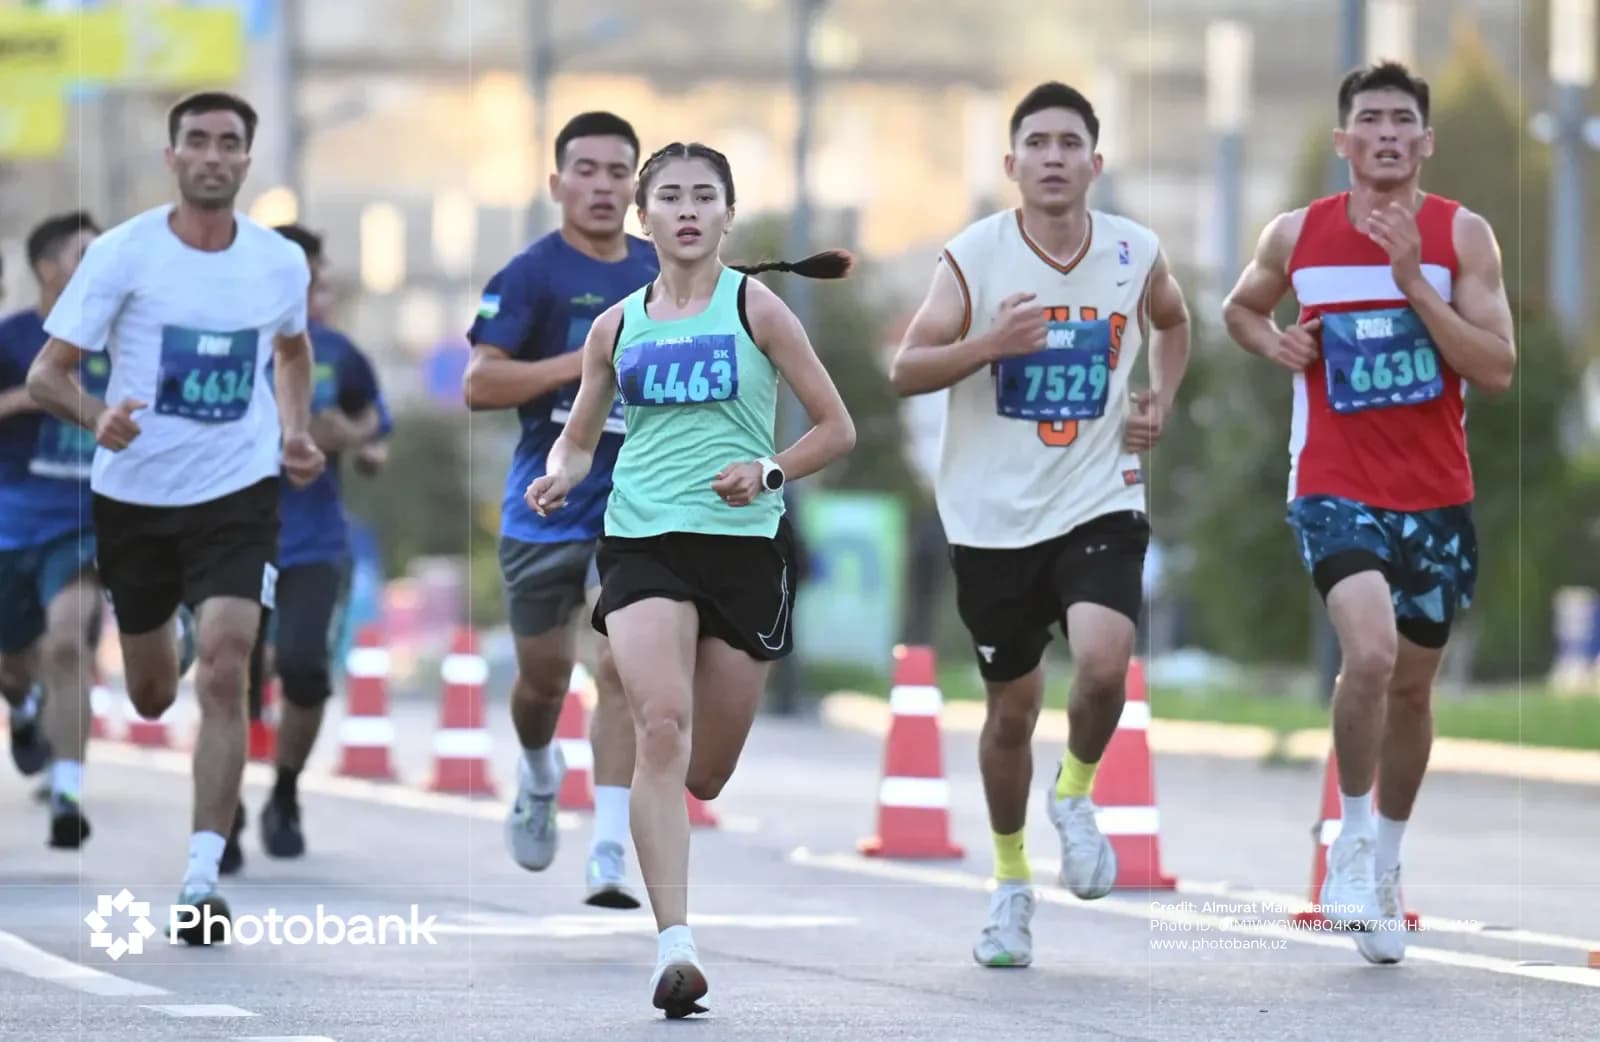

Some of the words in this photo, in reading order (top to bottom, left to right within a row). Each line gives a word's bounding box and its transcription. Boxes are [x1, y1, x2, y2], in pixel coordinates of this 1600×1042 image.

[712, 350, 729, 359] 5K
[1350, 347, 1437, 393] 6630
[643, 360, 732, 404] 4463
[1024, 364, 1107, 402] 7529
